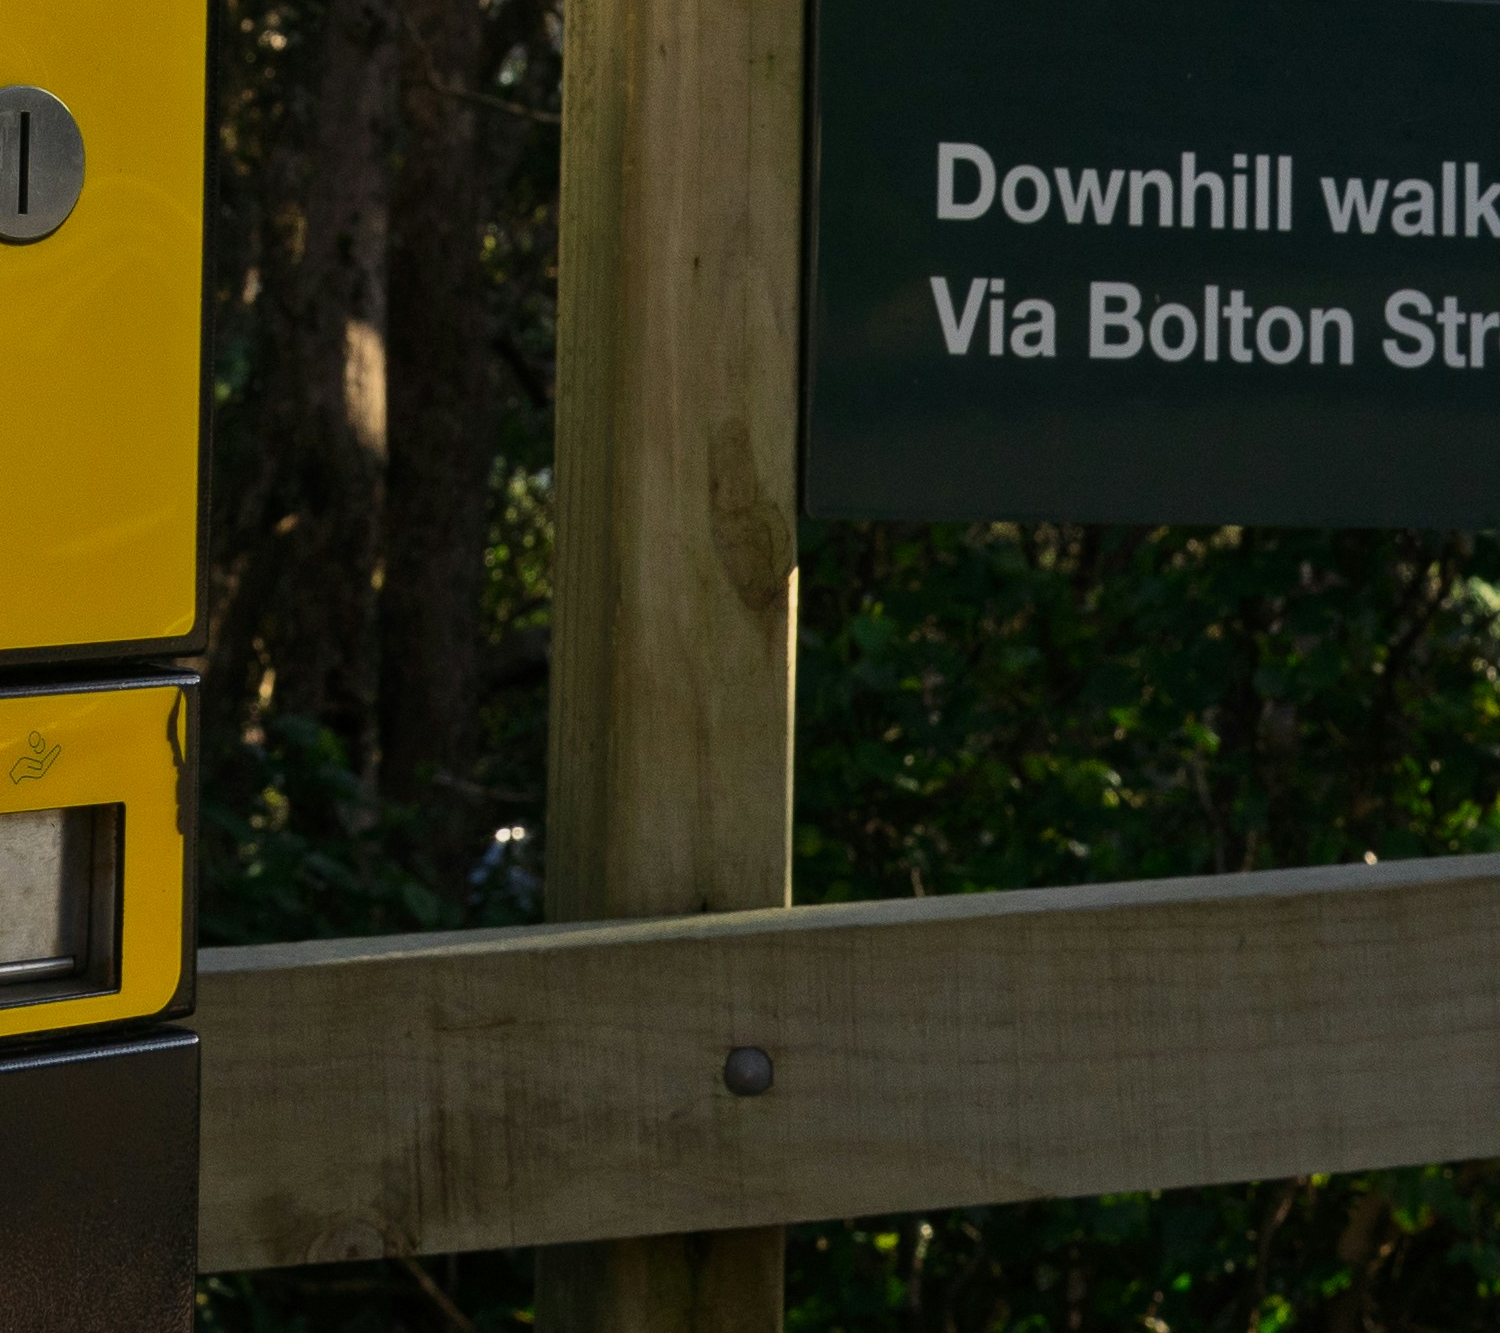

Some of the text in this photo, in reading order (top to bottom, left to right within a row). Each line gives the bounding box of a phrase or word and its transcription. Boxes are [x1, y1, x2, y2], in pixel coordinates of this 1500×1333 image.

[936, 141, 1293, 232] Downhill
[929, 275, 1056, 359] Via
[1088, 280, 1355, 367] Bolton
